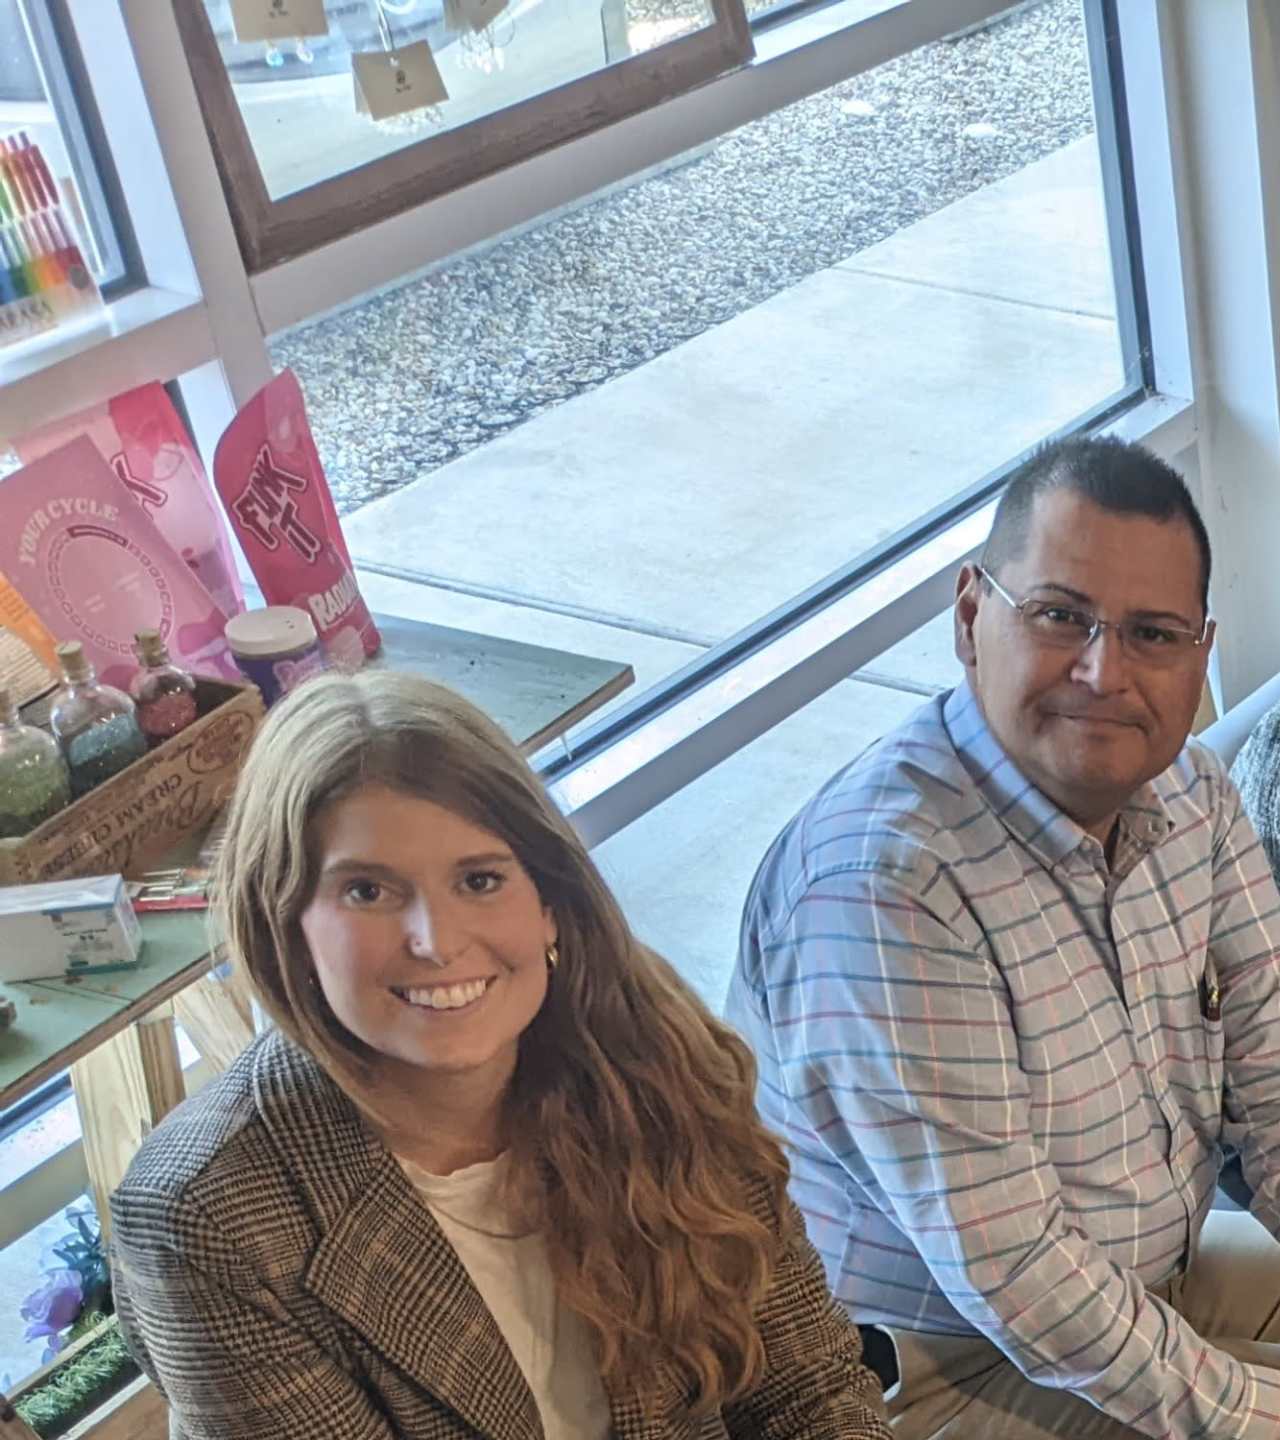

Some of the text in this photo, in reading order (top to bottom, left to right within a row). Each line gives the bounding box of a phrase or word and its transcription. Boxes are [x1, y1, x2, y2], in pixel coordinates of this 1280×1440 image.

[231, 443, 308, 551] FUNK
[19, 498, 121, 567] YOUR CYCLE
[116, 773, 183, 824] CREAM
